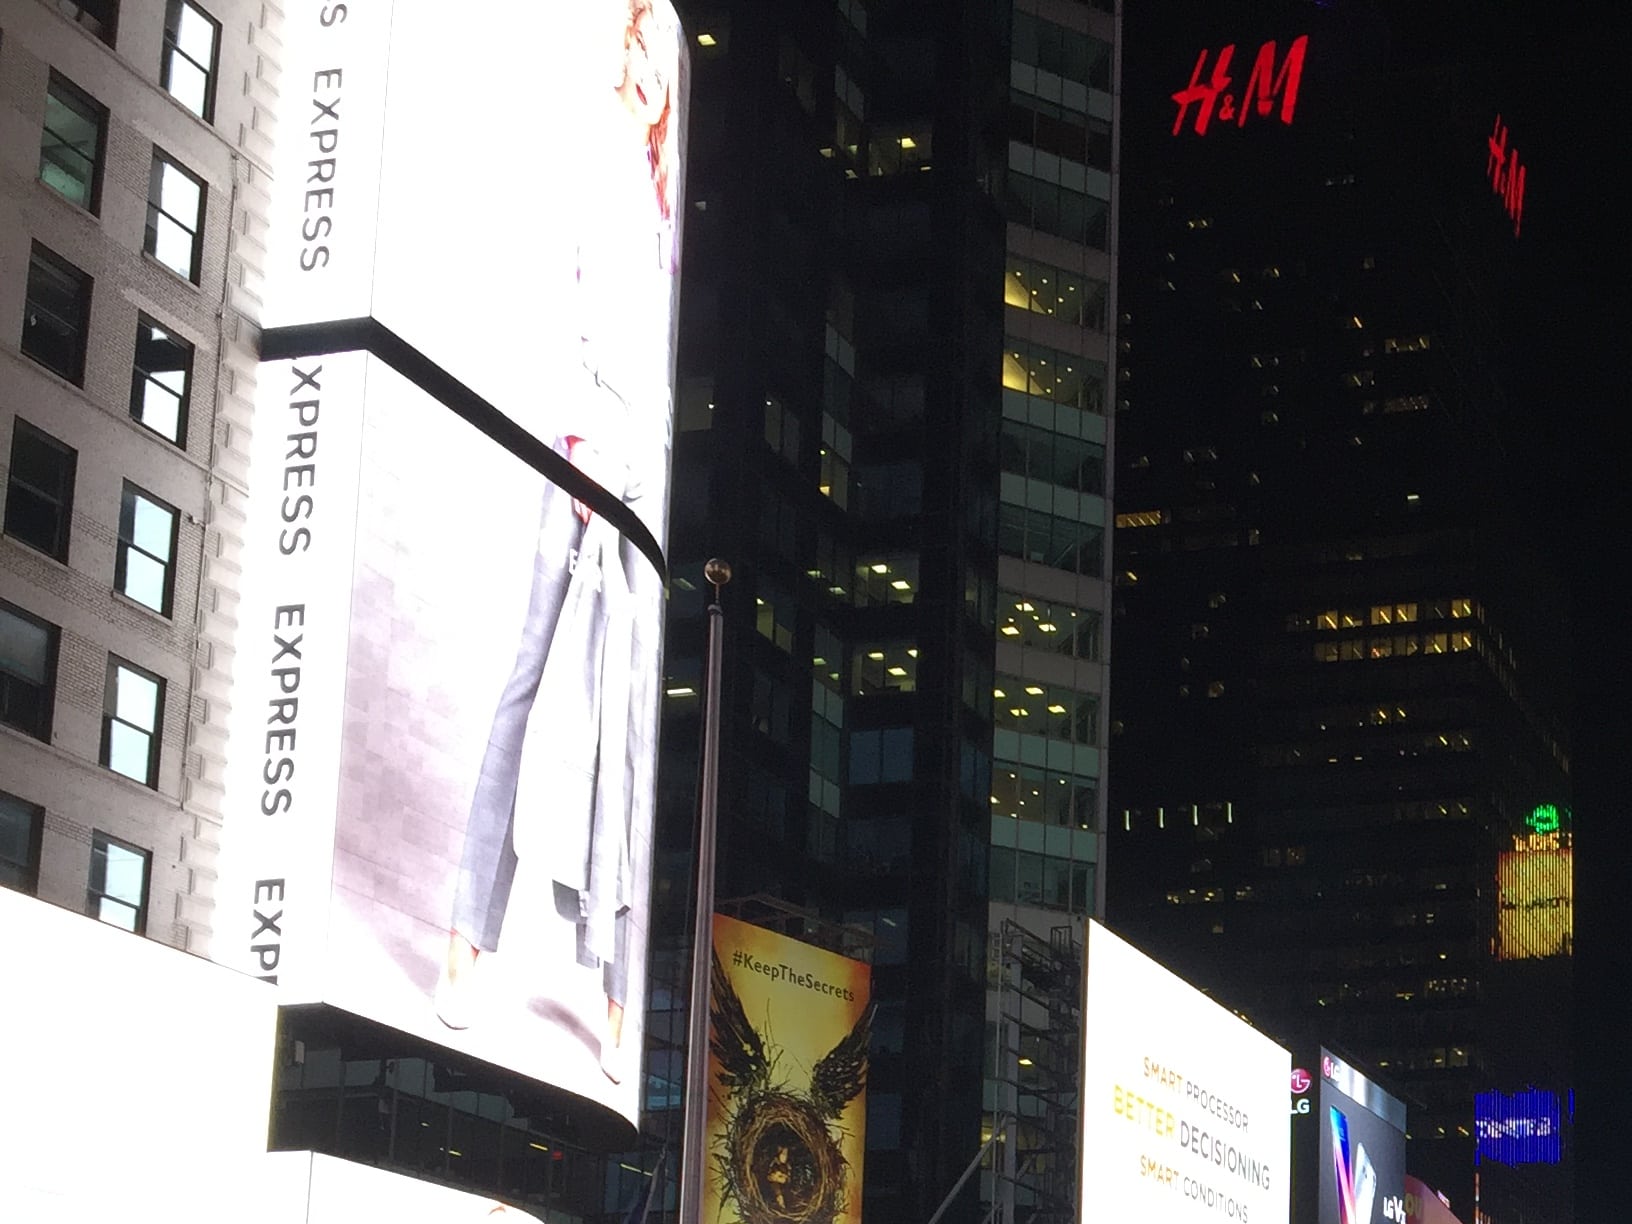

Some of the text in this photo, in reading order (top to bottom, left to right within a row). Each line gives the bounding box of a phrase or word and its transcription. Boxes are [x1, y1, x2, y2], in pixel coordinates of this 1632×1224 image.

[1171, 35, 1308, 136] H&M
[300, 68, 343, 272] EXPRESS
[278, 357, 323, 556] XPRESS
[261, 604, 305, 816] EXPRESS
[732, 950, 855, 1003] #KeepTheSecrets
[1114, 1084, 1269, 1190] BETTER DECISIONING
[1144, 1056, 1248, 1133] SMART PROCESSOR
[1290, 1099, 1310, 1114] LG
[1140, 1154, 1248, 1224] SMART CONDITIONS
